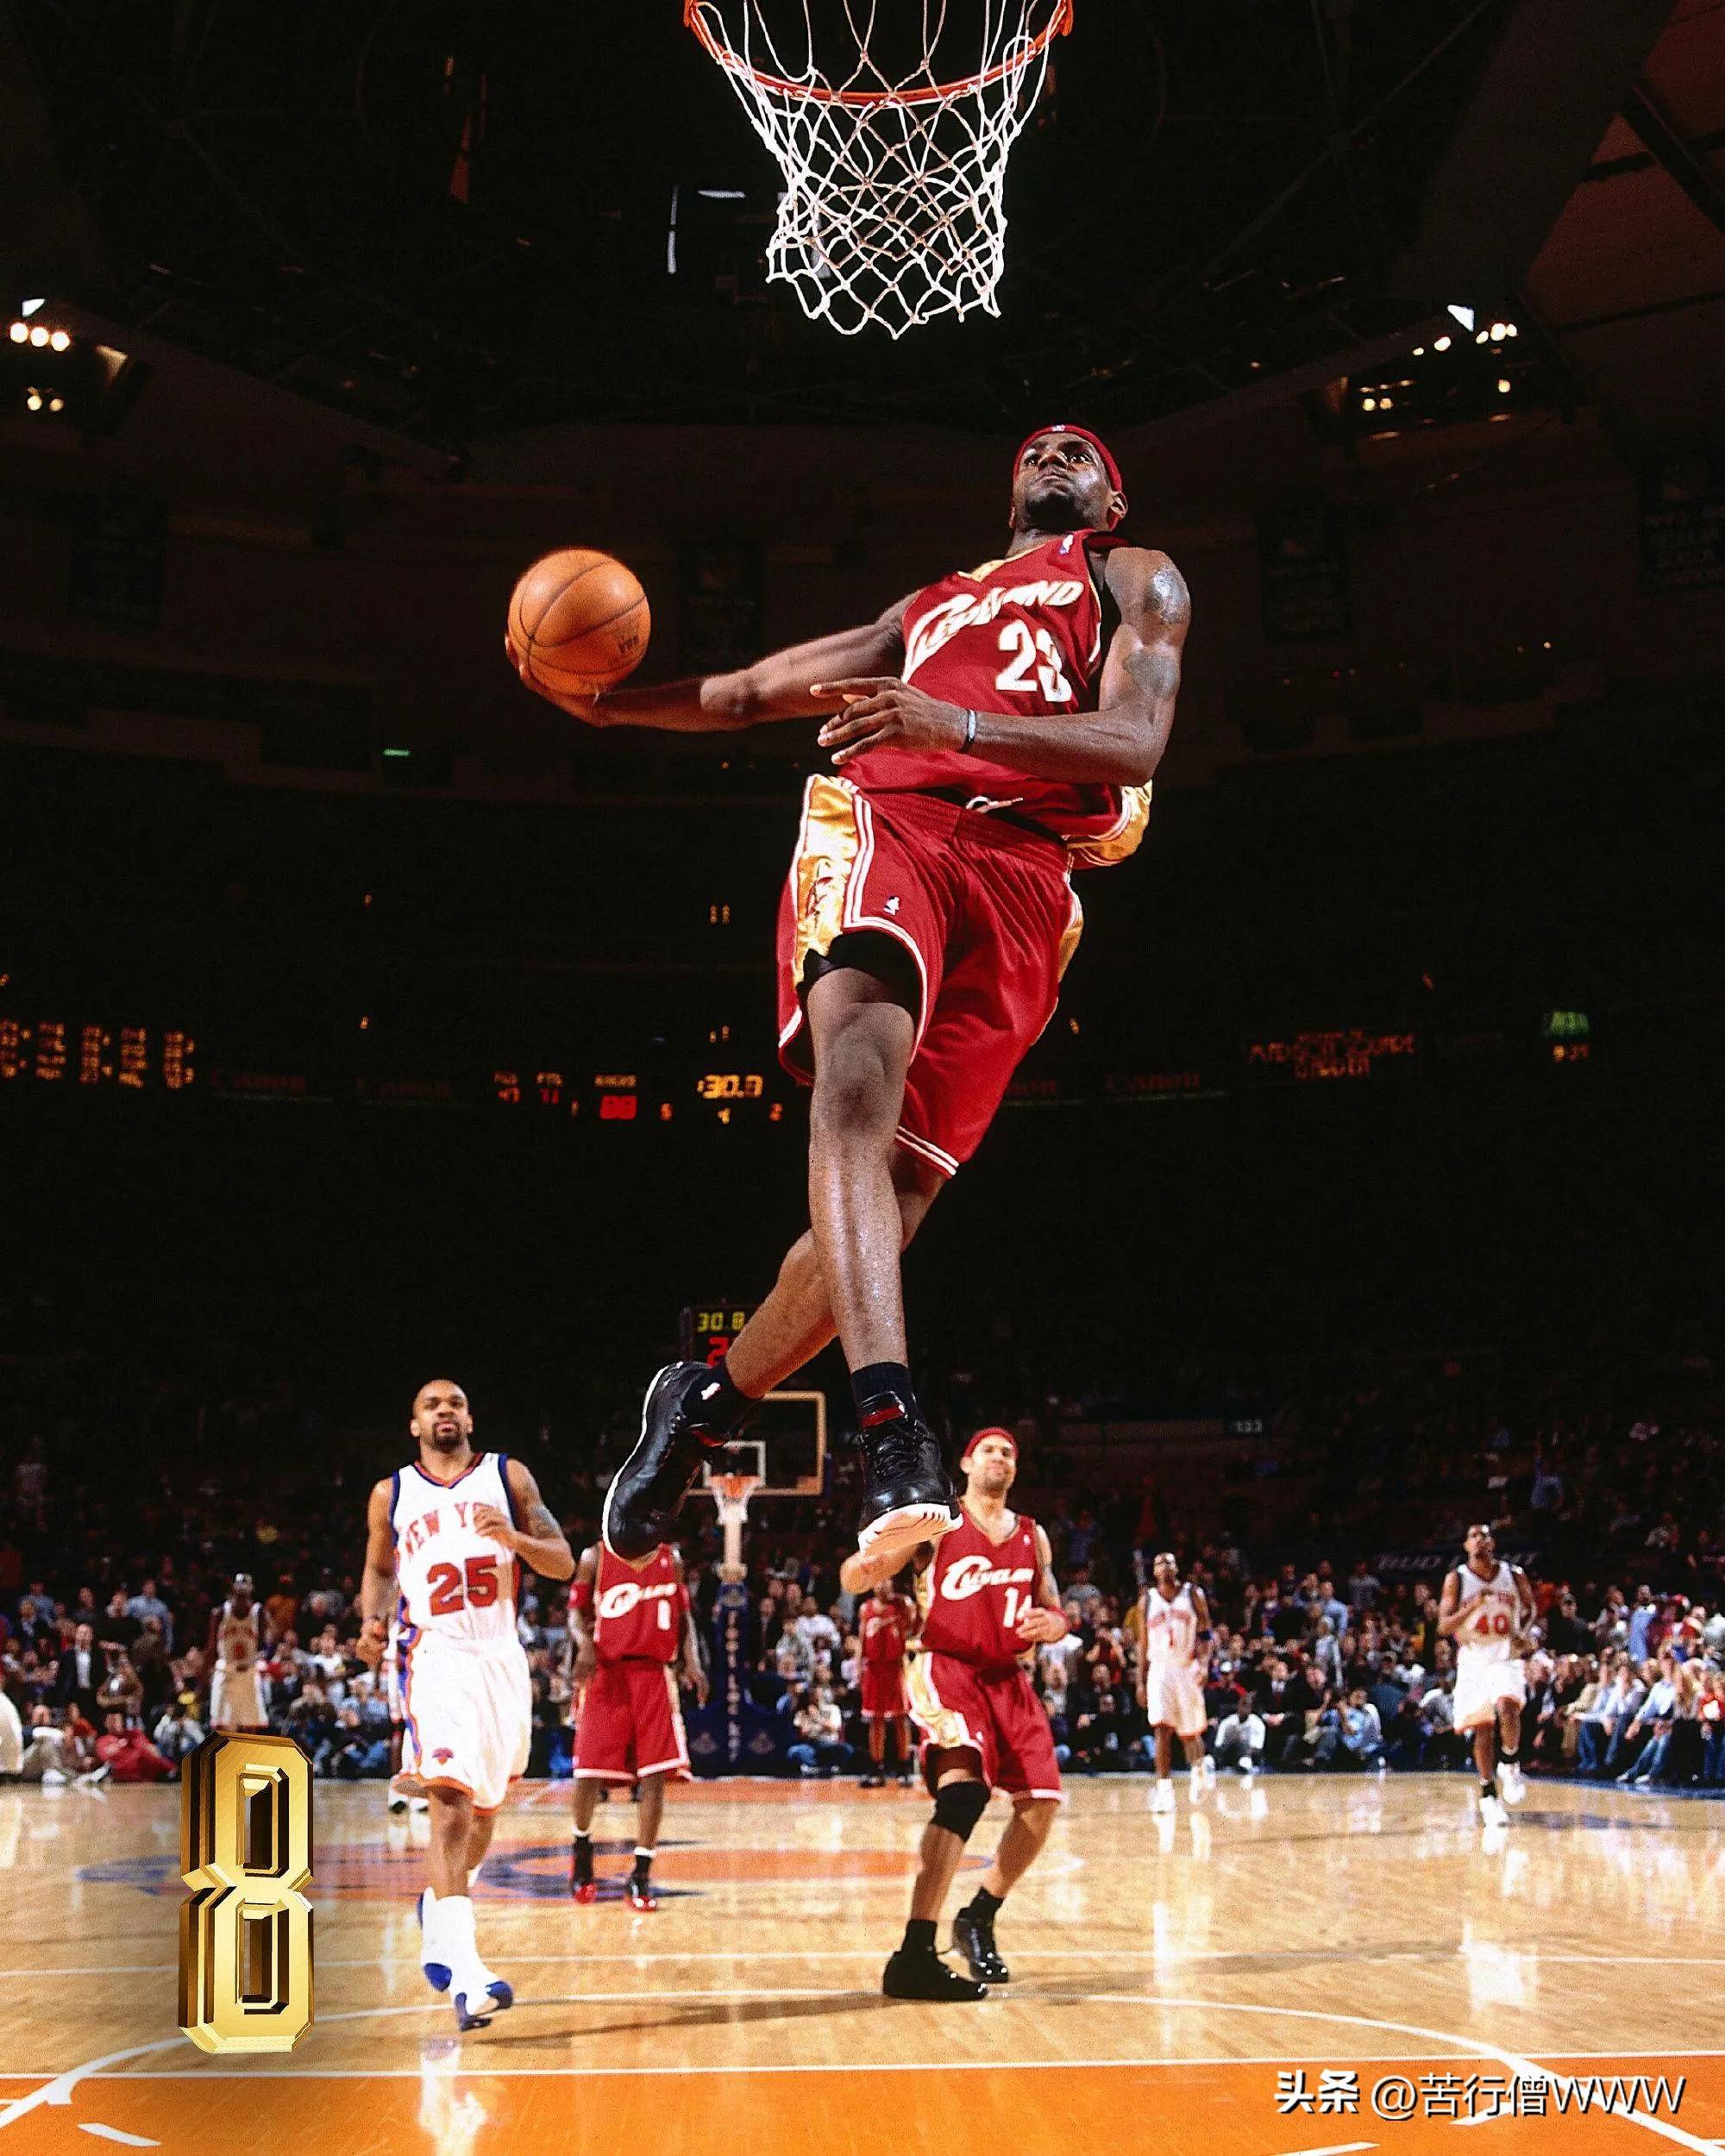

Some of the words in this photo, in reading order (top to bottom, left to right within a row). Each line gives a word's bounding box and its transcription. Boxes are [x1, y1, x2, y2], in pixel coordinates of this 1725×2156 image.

[995, 618, 1073, 703] 23
[426, 1555, 498, 1616] 25
[1475, 1613, 1509, 1635] 40
